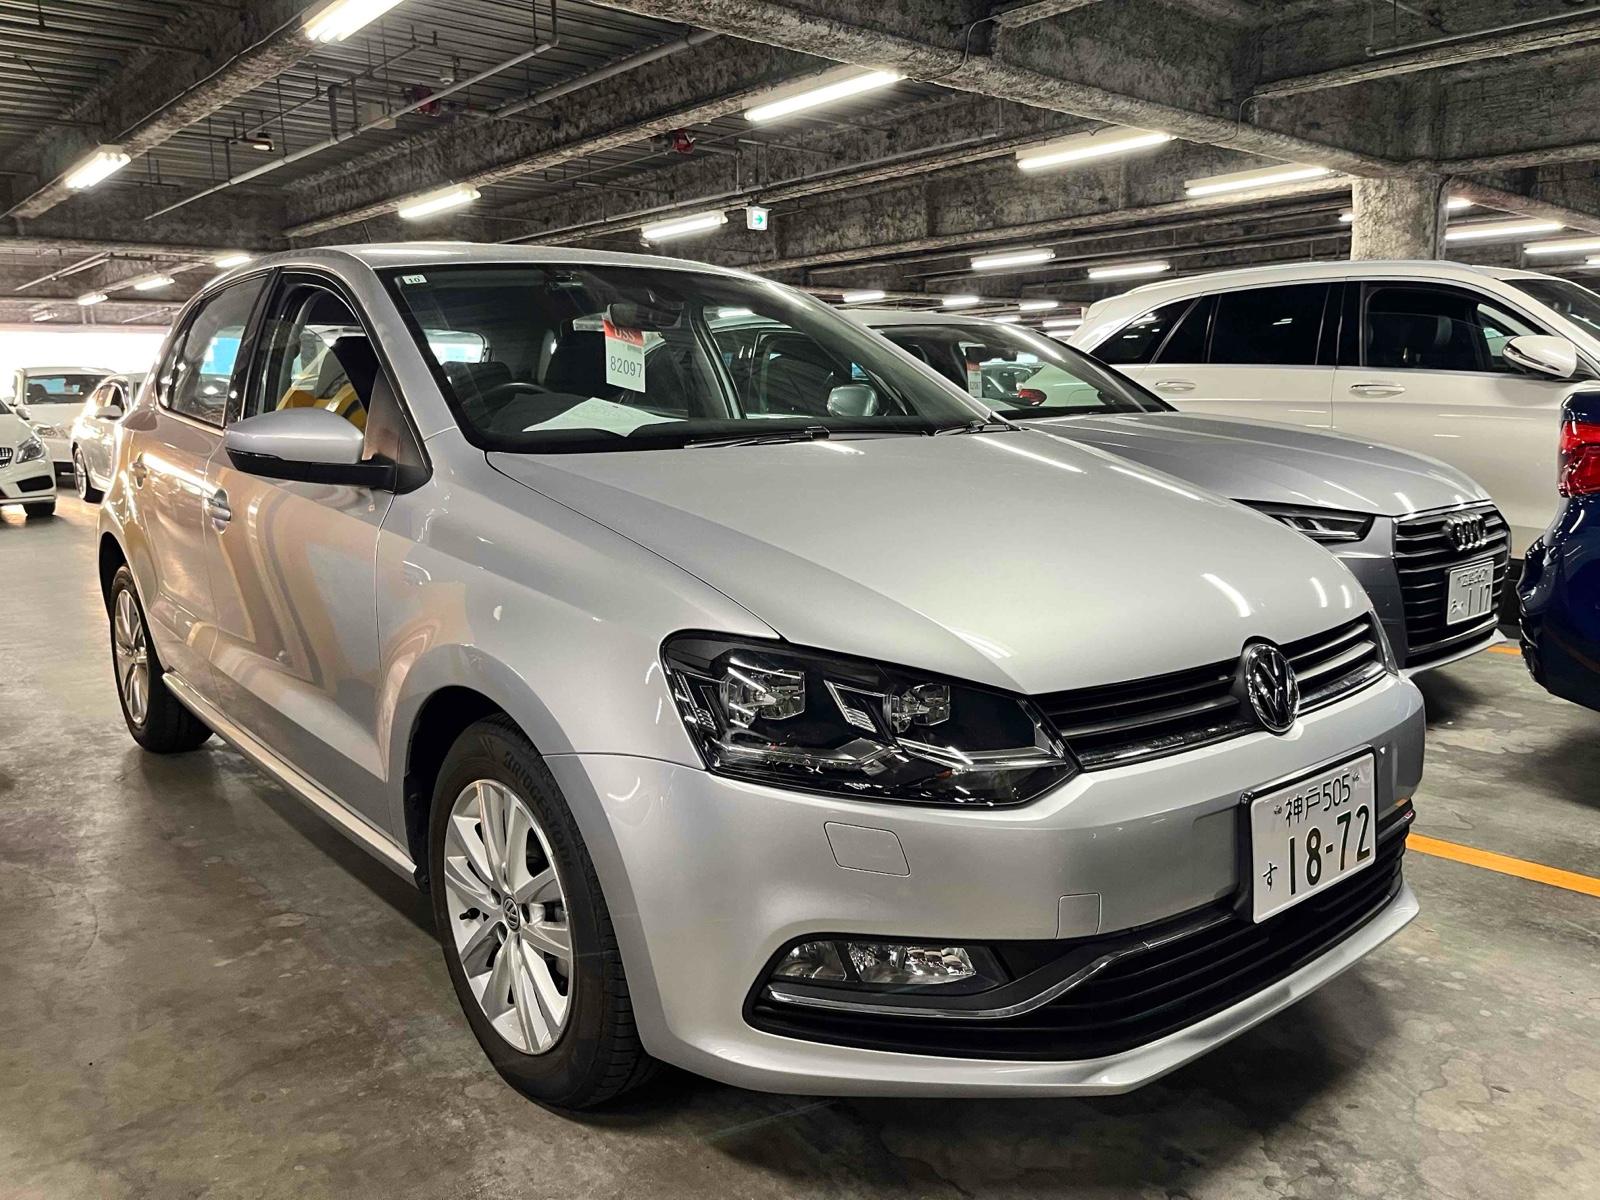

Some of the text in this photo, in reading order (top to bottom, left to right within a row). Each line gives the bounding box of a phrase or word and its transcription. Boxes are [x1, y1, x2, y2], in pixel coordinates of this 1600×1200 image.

[614, 328, 636, 342] USS
[610, 355, 643, 378] 82097
[1289, 804, 1371, 896] 18-72
